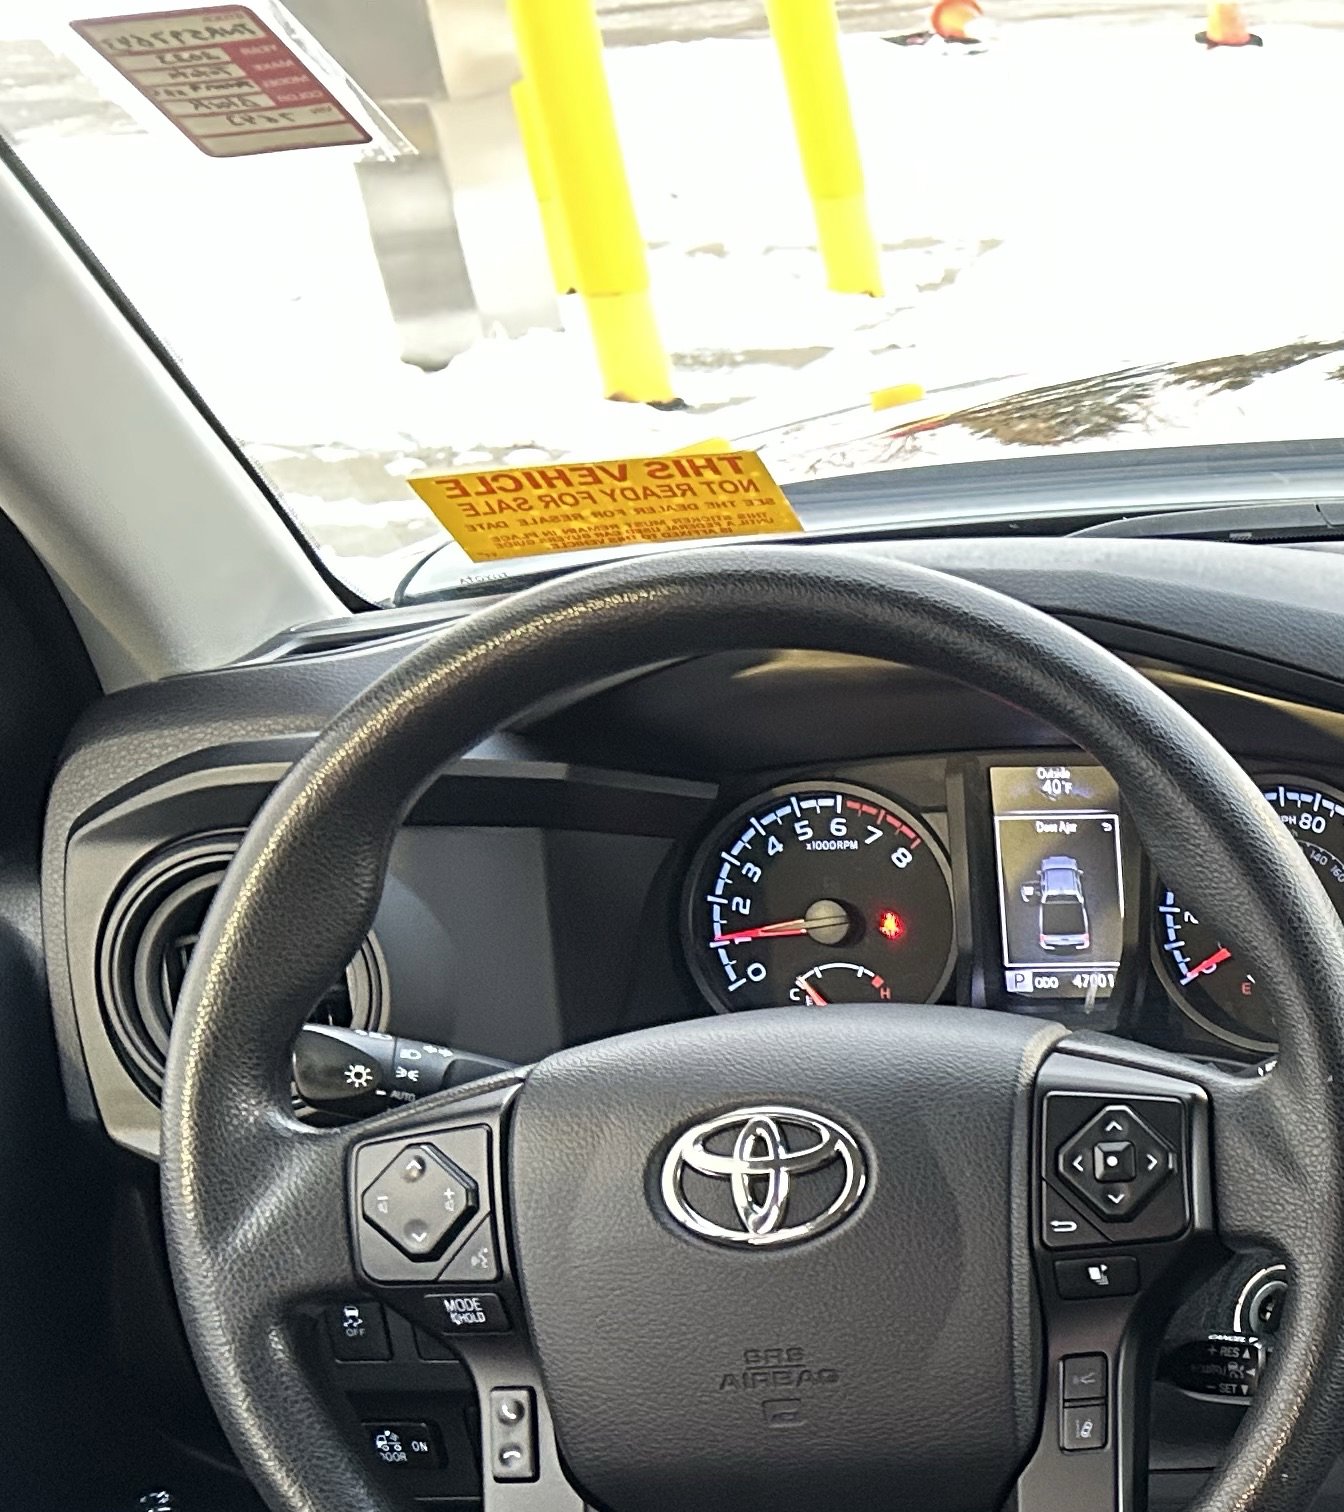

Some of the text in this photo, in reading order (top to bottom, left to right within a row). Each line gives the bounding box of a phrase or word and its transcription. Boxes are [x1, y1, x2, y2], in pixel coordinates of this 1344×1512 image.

[794, 820, 813, 840] 5
[830, 818, 848, 836] 6
[1298, 813, 1326, 834] 80
[865, 825, 883, 844] 7
[767, 836, 783, 856] 4
[891, 847, 912, 868] 8
[741, 863, 762, 882] 3
[732, 896, 750, 915] 2
[747, 963, 766, 981] 0
[1014, 973, 1025, 989] P
[880, 987, 891, 999] H
[1241, 982, 1251, 995] E
[444, 1298, 483, 1312] MODE
[459, 1312, 486, 1324] HOLD
[346, 1329, 365, 1337] OFF
[1220, 1346, 1240, 1358] RES
[411, 1441, 428, 1452] ON
